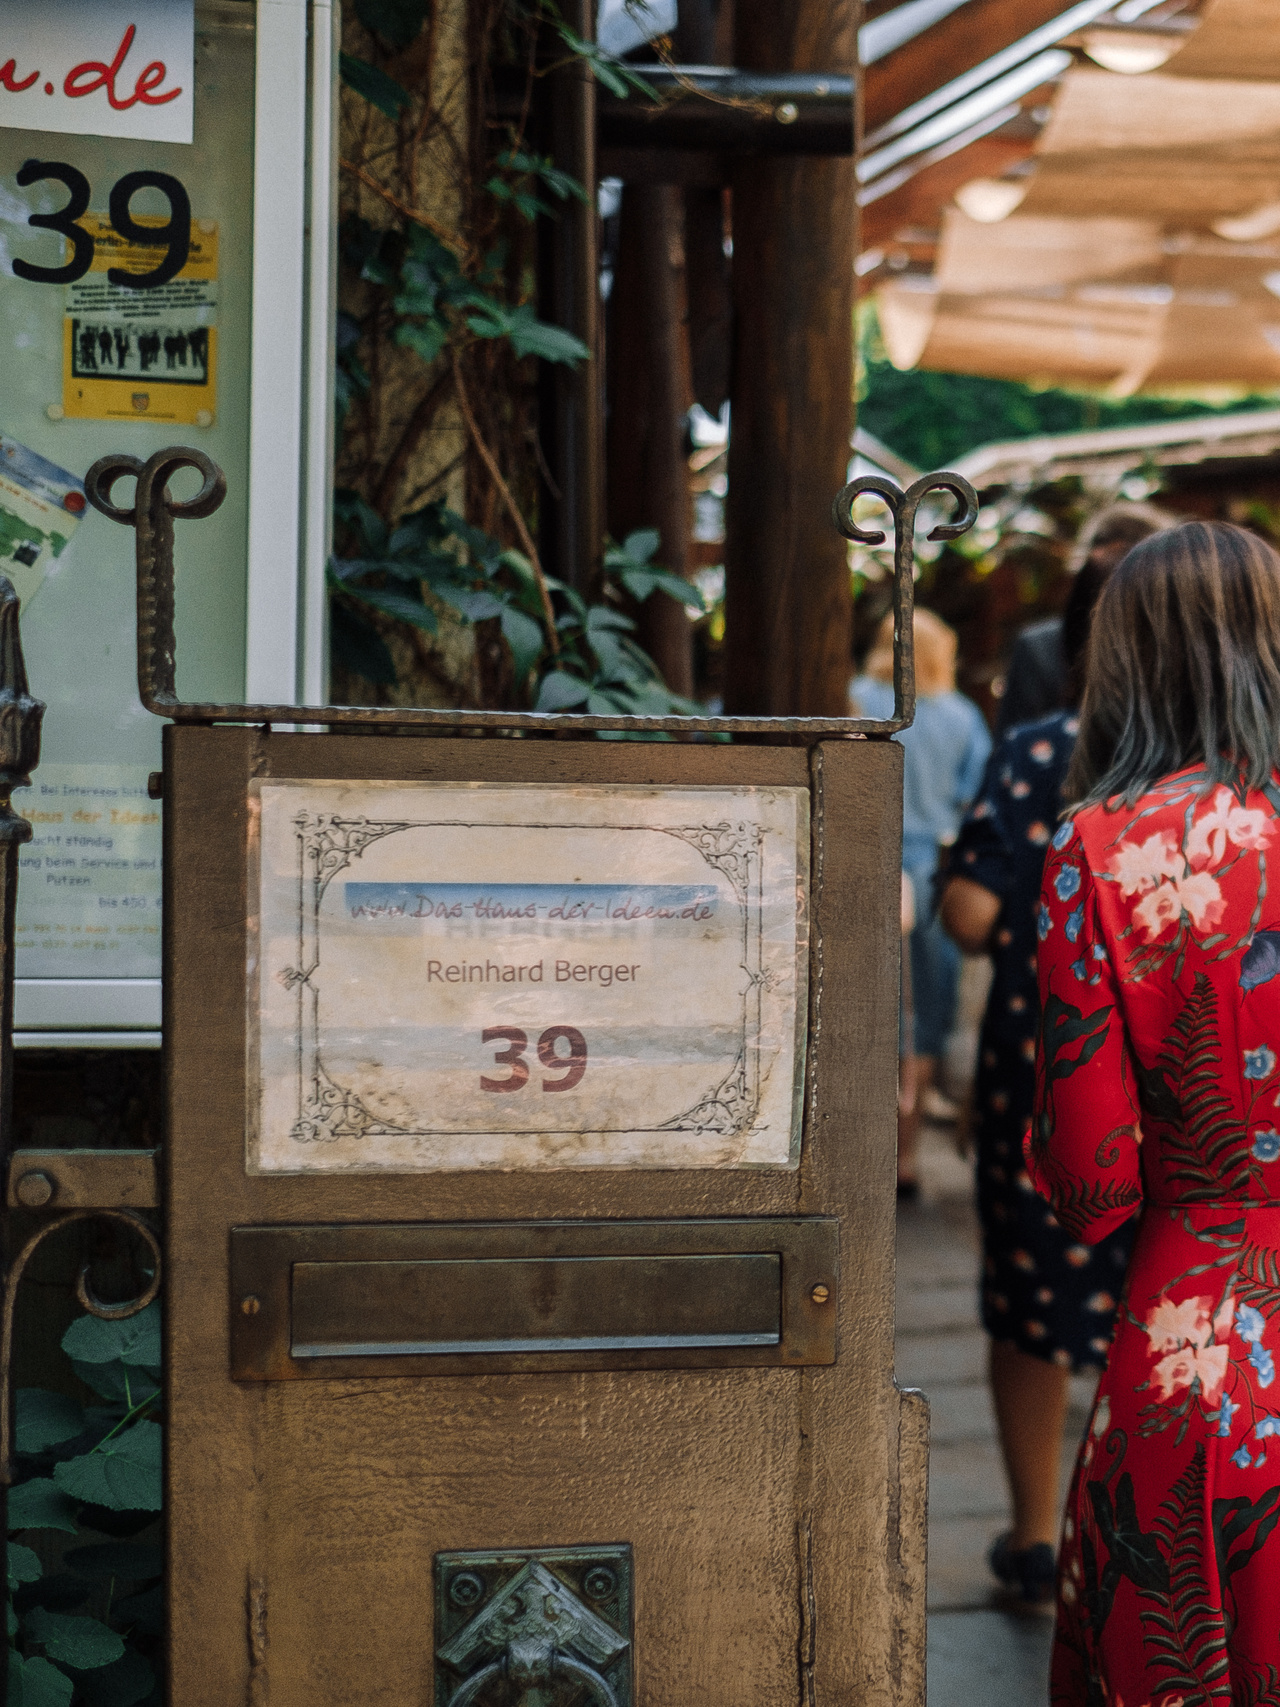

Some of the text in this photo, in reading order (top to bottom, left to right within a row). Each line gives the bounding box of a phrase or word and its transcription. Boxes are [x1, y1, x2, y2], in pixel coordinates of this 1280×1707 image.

[11, 160, 192, 290] 39
[46, 873, 91, 886] Putzen
[426, 959, 641, 988] Reinhard Berger
[478, 1025, 589, 1094] 39
